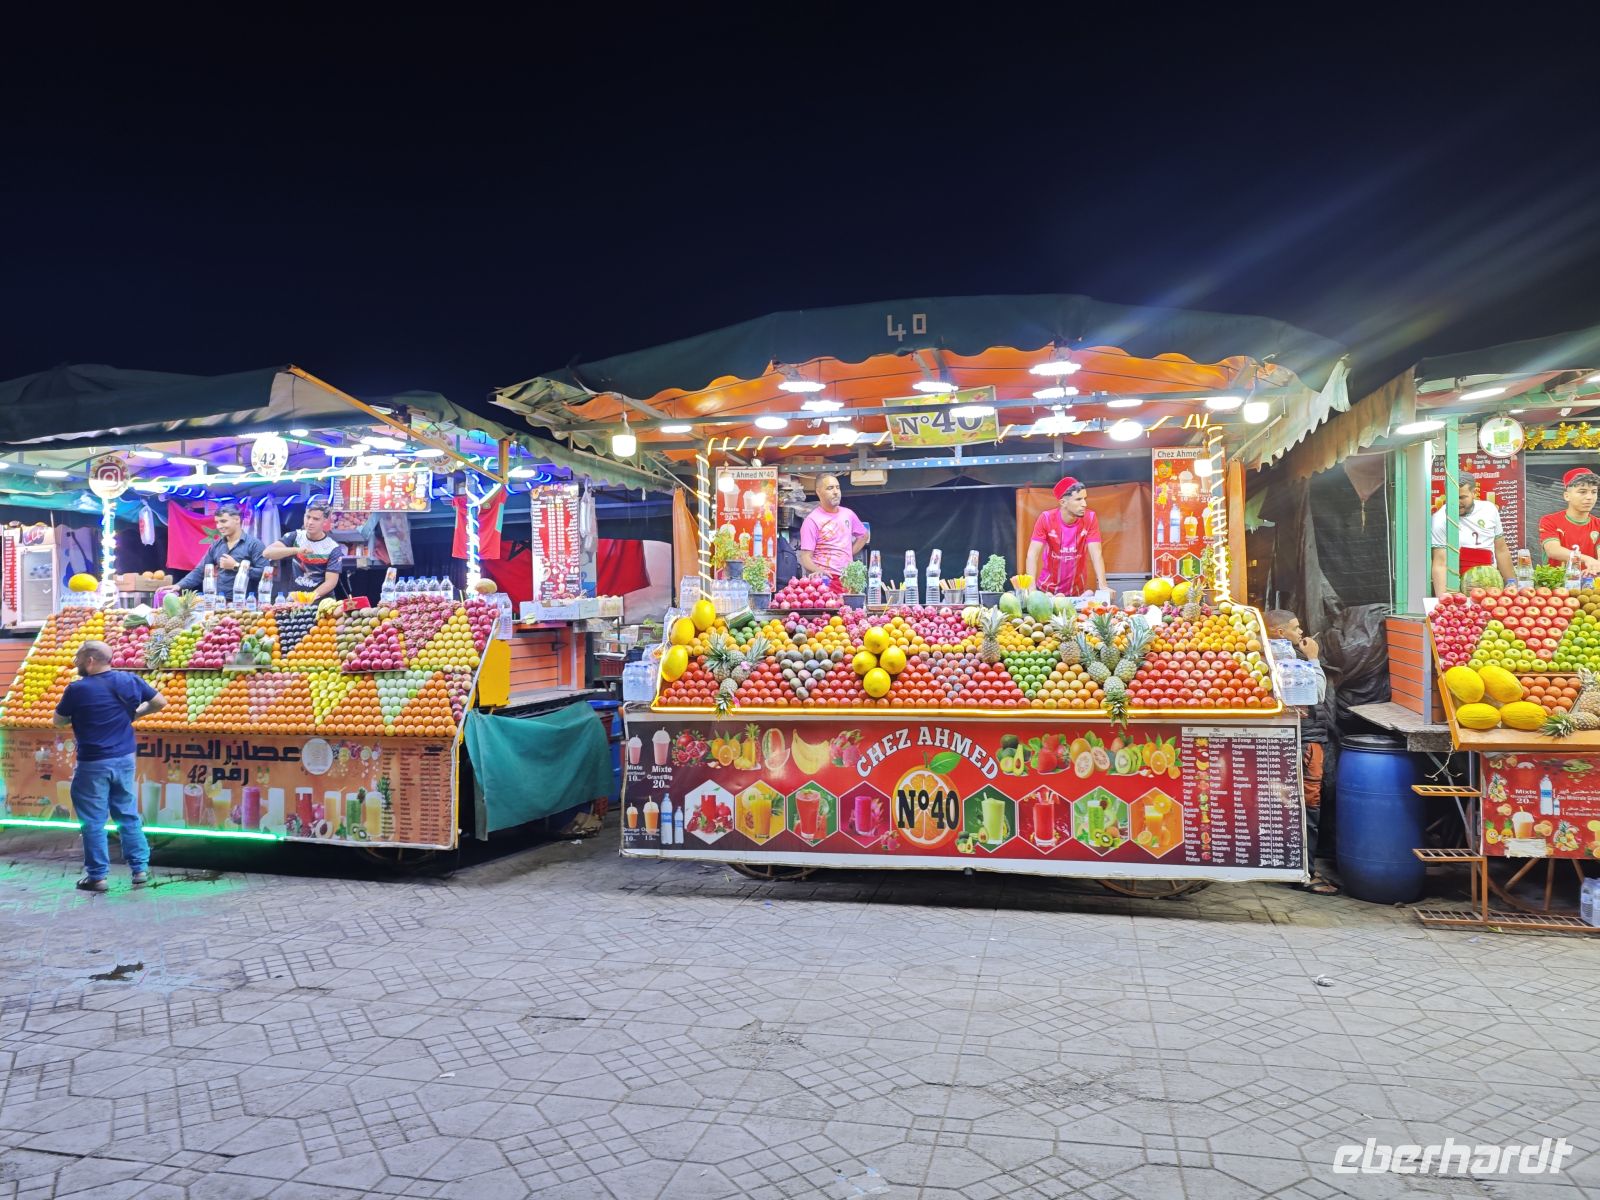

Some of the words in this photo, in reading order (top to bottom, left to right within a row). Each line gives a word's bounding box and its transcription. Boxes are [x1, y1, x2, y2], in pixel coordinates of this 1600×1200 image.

[887, 314, 926, 341] 40
[260, 453, 276, 465] 42
[1157, 450, 1174, 458] Chez
[736, 471, 757, 479] Ahmed
[1472, 532, 1481, 545] 2
[856, 728, 911, 777] CHEZ
[917, 726, 999, 780] AHMED
[212, 763, 249, 786] رقم
